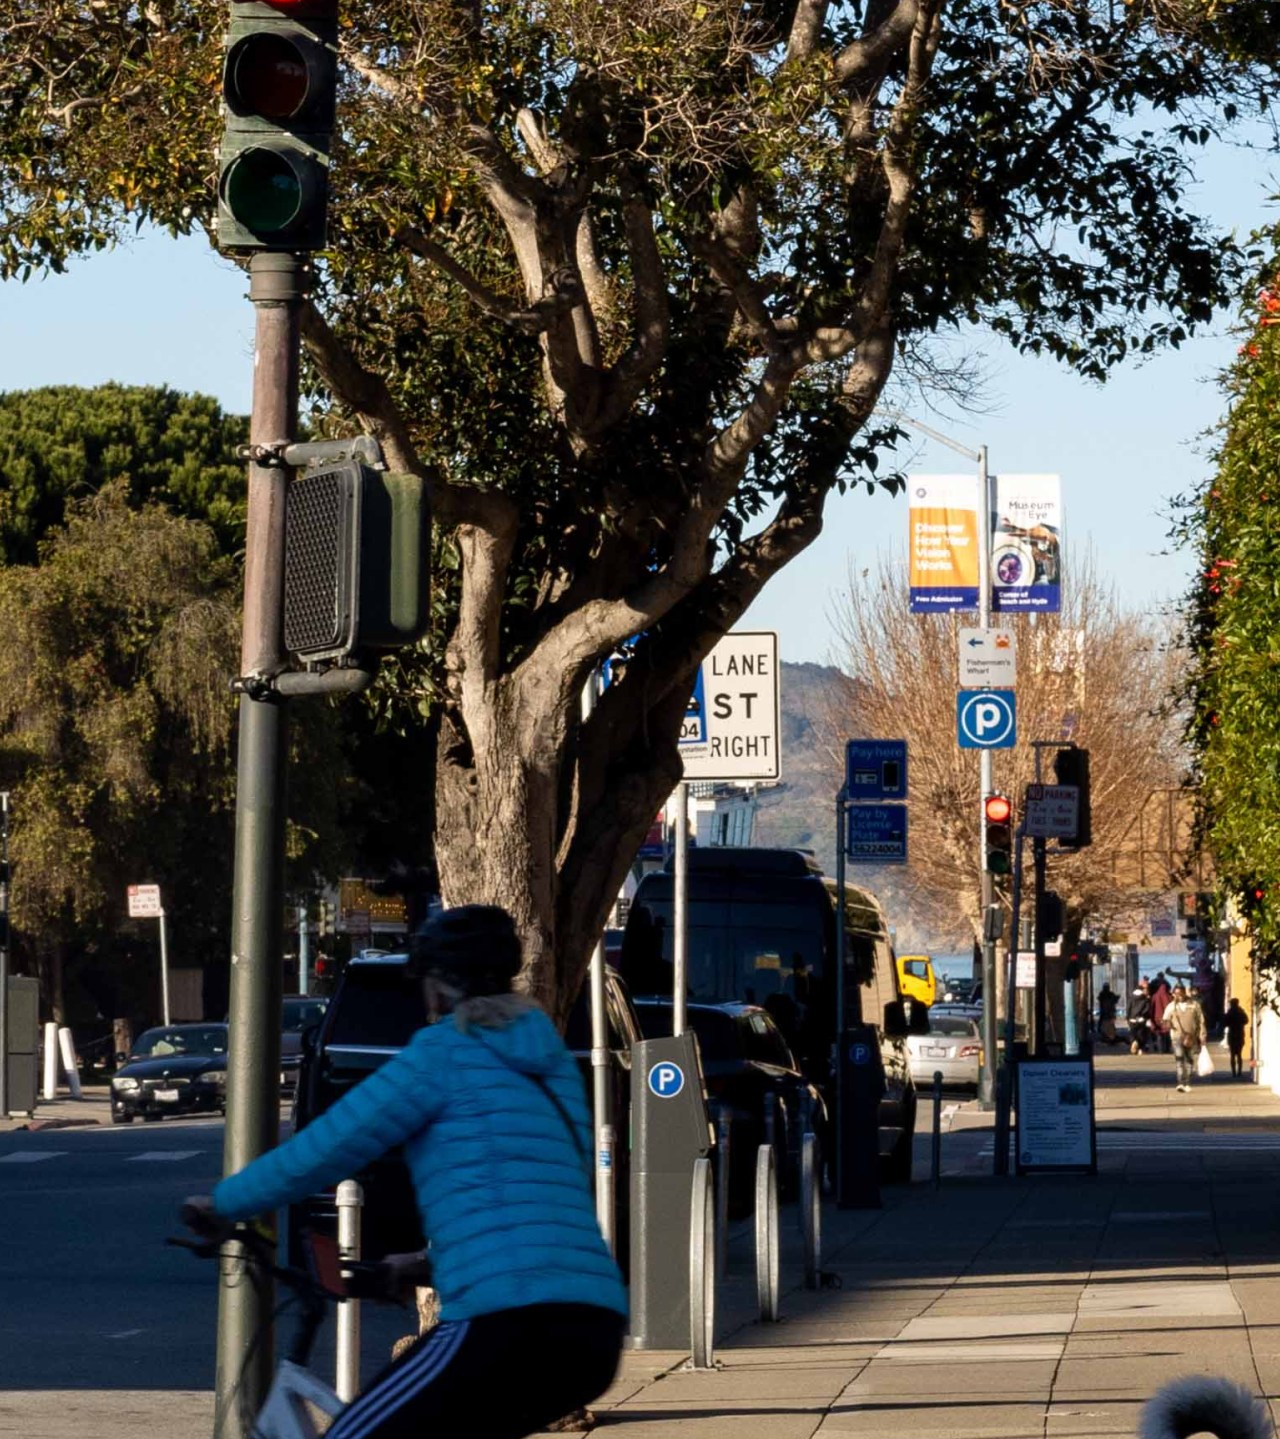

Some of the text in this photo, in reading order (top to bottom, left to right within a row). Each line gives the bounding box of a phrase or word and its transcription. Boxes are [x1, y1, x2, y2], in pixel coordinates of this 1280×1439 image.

[1008, 500, 1055, 511] Museum
[1028, 510, 1048, 521] Eye
[713, 654, 769, 676] LANE
[713, 692, 759, 720] ST
[679, 722, 699, 739] 04
[710, 735, 771, 758] RIGHT
[851, 746, 873, 760] Pay
[659, 1068, 675, 1092] P
